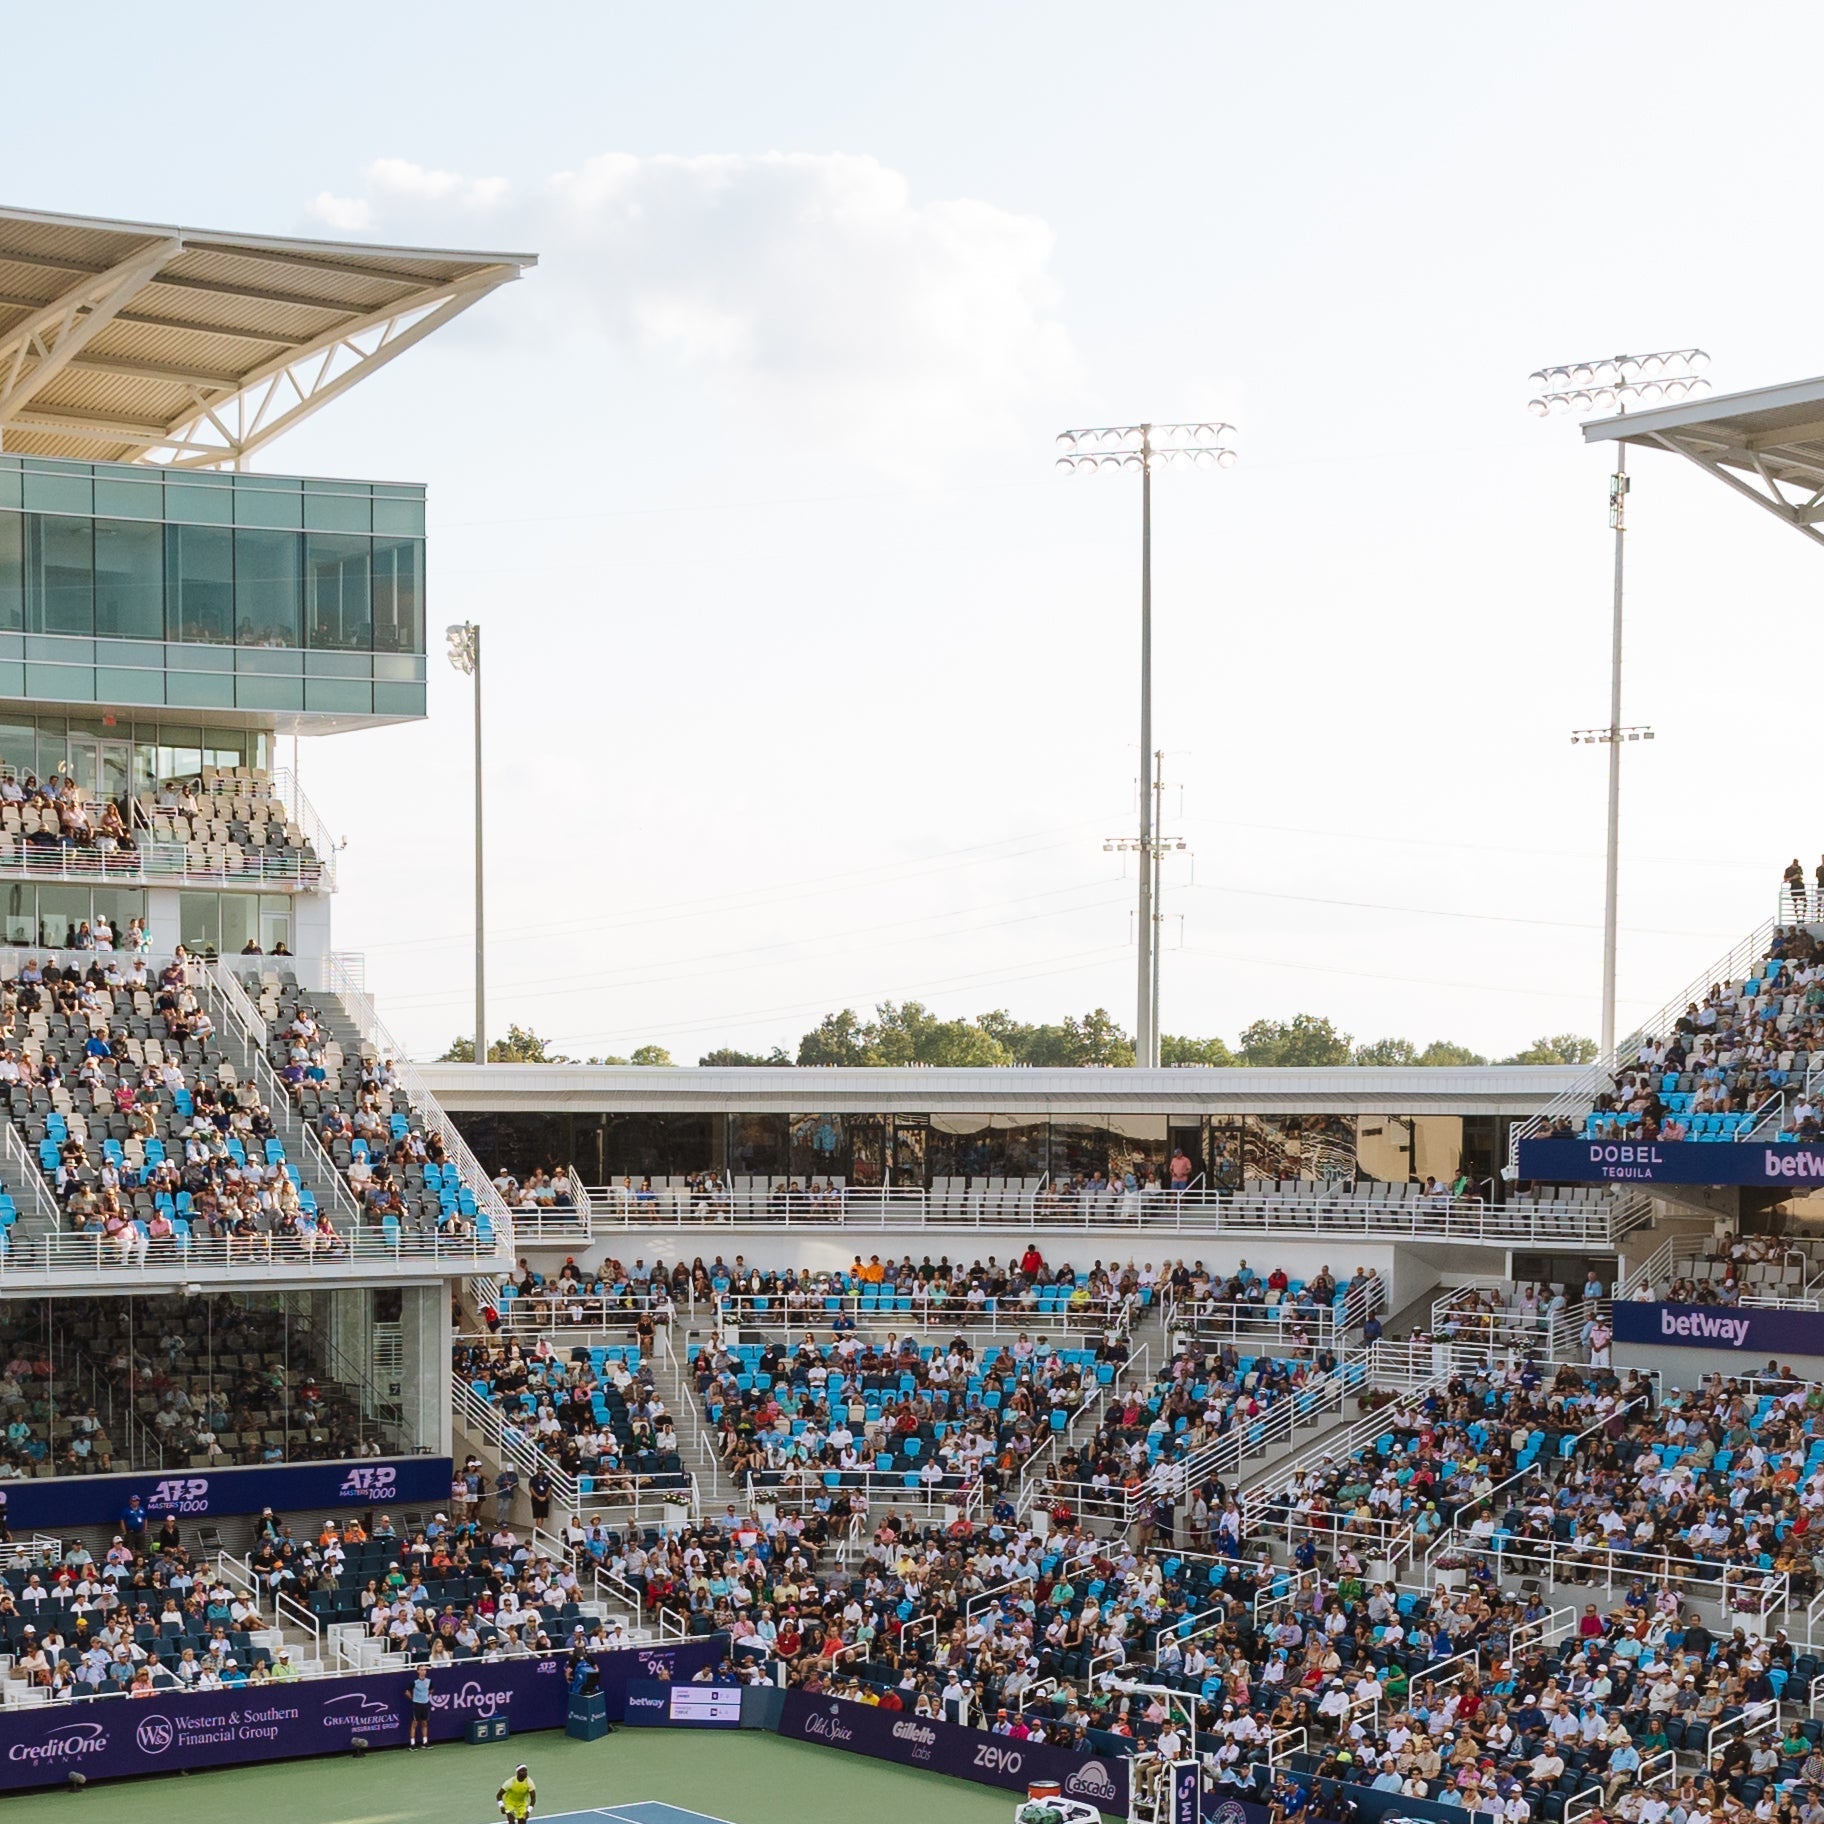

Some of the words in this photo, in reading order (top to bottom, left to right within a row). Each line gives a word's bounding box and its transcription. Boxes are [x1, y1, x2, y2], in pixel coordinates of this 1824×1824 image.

[1590, 1146, 1663, 1162] DOBEL
[1602, 1167, 1653, 1178] TEQUILA
[1662, 1308, 1750, 1346] betway
[339, 1467, 396, 1490] ATP
[146, 1479, 208, 1503] ATP
[368, 1487, 396, 1500] 1000
[147, 1501, 179, 1510] MASTERS
[178, 1500, 208, 1512] 1000
[647, 1660, 665, 1675] 96
[454, 1681, 514, 1718] Kroger
[629, 1697, 664, 1708] betway
[176, 1714, 226, 1730] Western
[228, 1711, 240, 1725] &
[243, 1706, 299, 1723] Southern
[323, 1716, 355, 1727] GREAT
[353, 1713, 399, 1726] AMERICAN
[351, 1725, 380, 1733] INSURANCE
[381, 1723, 399, 1731] GROUP
[805, 1713, 827, 1735] Old
[825, 1718, 854, 1741] Spice
[138, 1724, 171, 1746] W&S
[178, 1725, 235, 1746] Financial
[238, 1724, 279, 1741] Group
[892, 1721, 936, 1746] Gillette
[9, 1736, 107, 1761] CreditOne
[32, 1754, 83, 1767] BANK
[1065, 1773, 1116, 1800] Cascade
